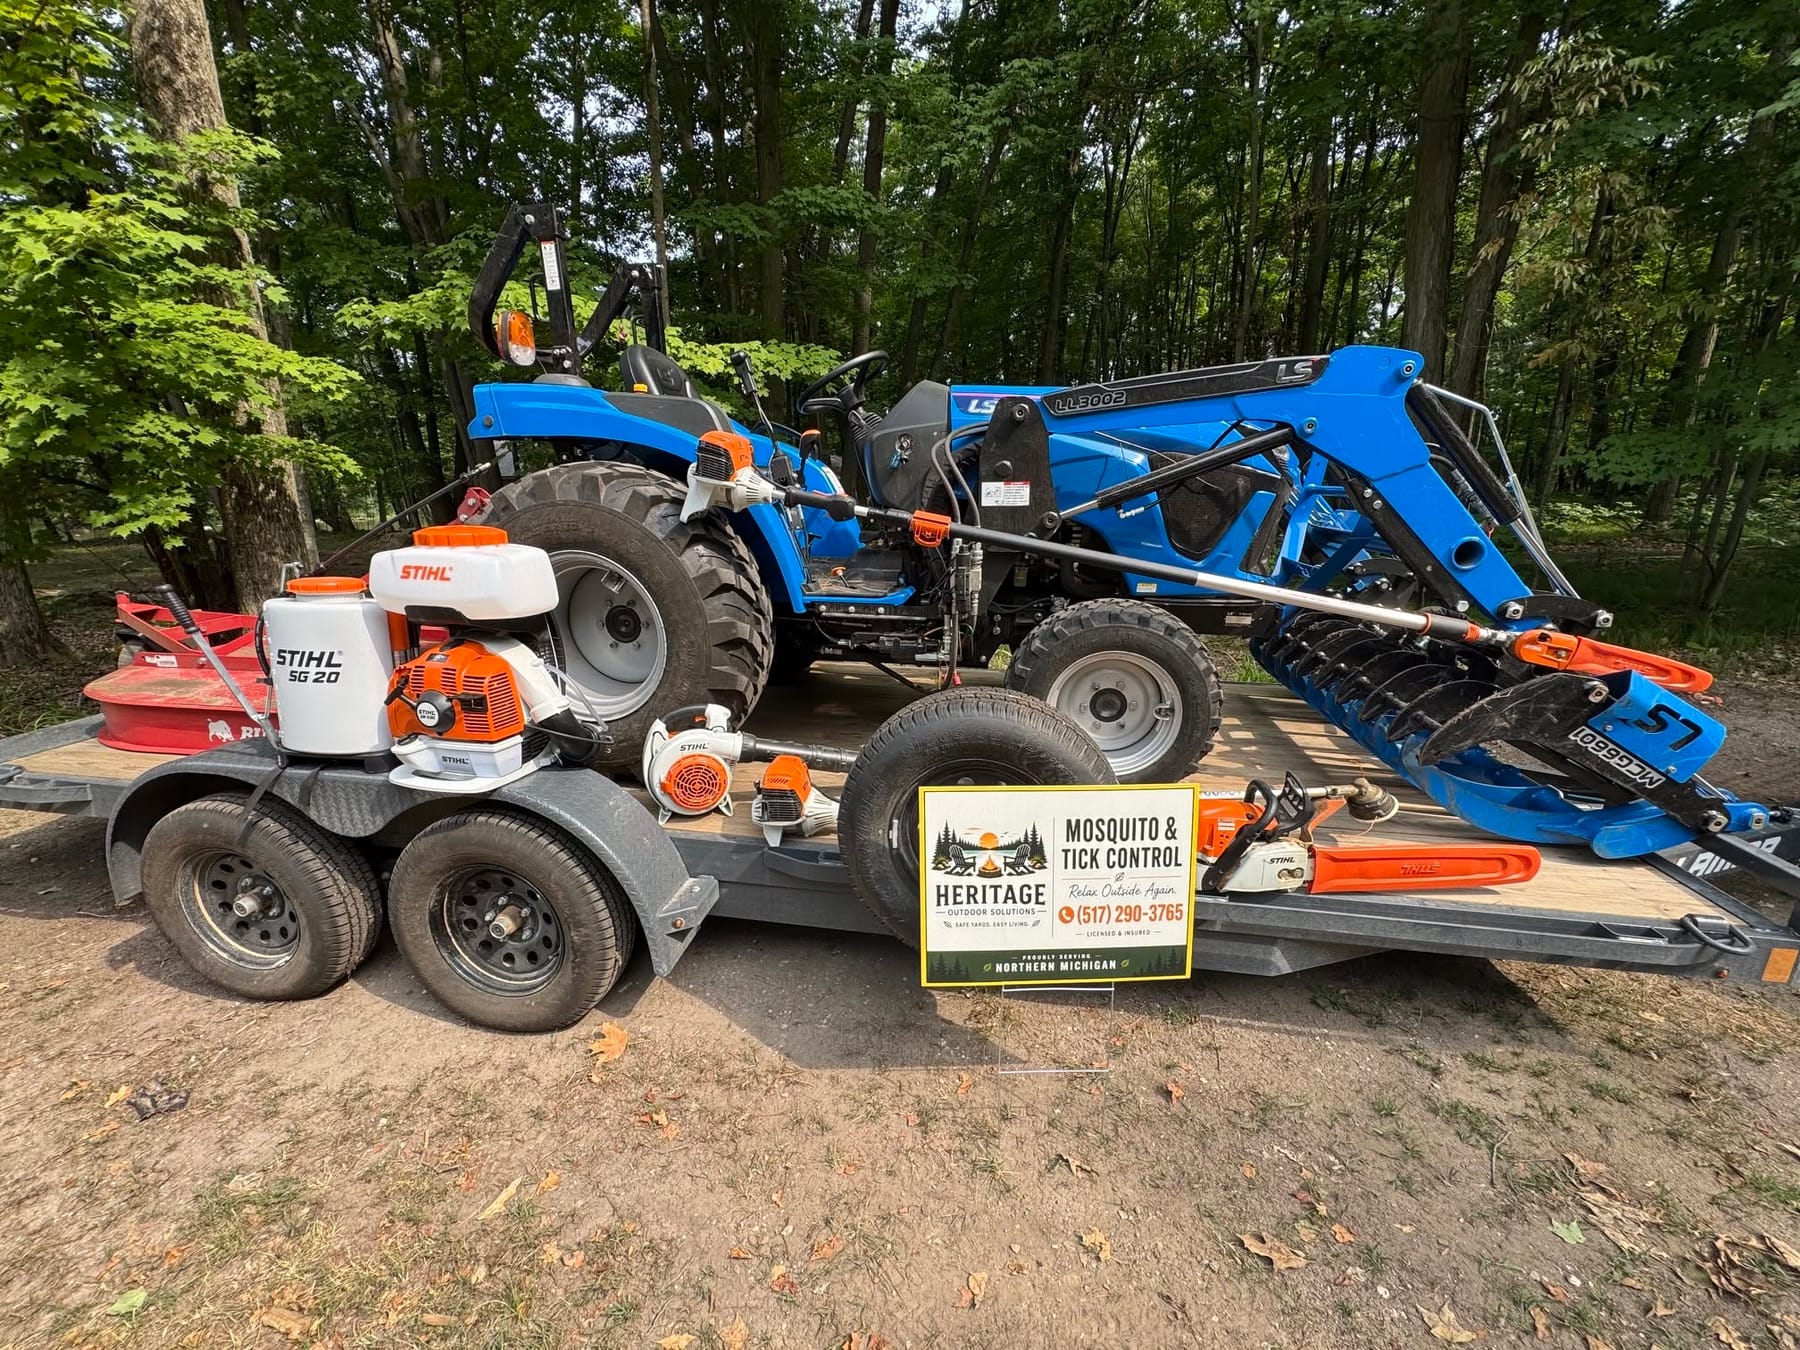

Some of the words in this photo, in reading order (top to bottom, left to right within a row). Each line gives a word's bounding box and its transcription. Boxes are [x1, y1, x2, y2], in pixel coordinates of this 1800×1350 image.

[1275, 360, 1312, 383] LS
[1055, 391, 1127, 412] LL3002
[400, 565, 451, 581] STIHL
[276, 649, 342, 668] STIHL
[289, 670, 309, 682] SG
[312, 671, 340, 683] 20
[680, 743, 708, 751] STIHL
[442, 756, 468, 764] STIHL
[1569, 727, 1664, 788] MCG6601
[1066, 816, 1159, 844] MOSQUITO
[1165, 816, 1177, 840] &
[1061, 848, 1099, 870] TICK
[1106, 846, 1182, 869] CONTROL
[936, 884, 1046, 907] HERITAGE
[1069, 884, 1098, 898] Relax
[1101, 883, 1141, 898] Outside
[1144, 882, 1176, 900] Again.
[947, 908, 987, 916] OUTDOOR
[990, 908, 1036, 916] SOLUTIONS
[1077, 903, 1111, 925] (517)
[1115, 903, 1184, 923] 290-3765
[995, 962, 1055, 973] NORTHERN
[1060, 960, 1117, 971] MICHIGAN
